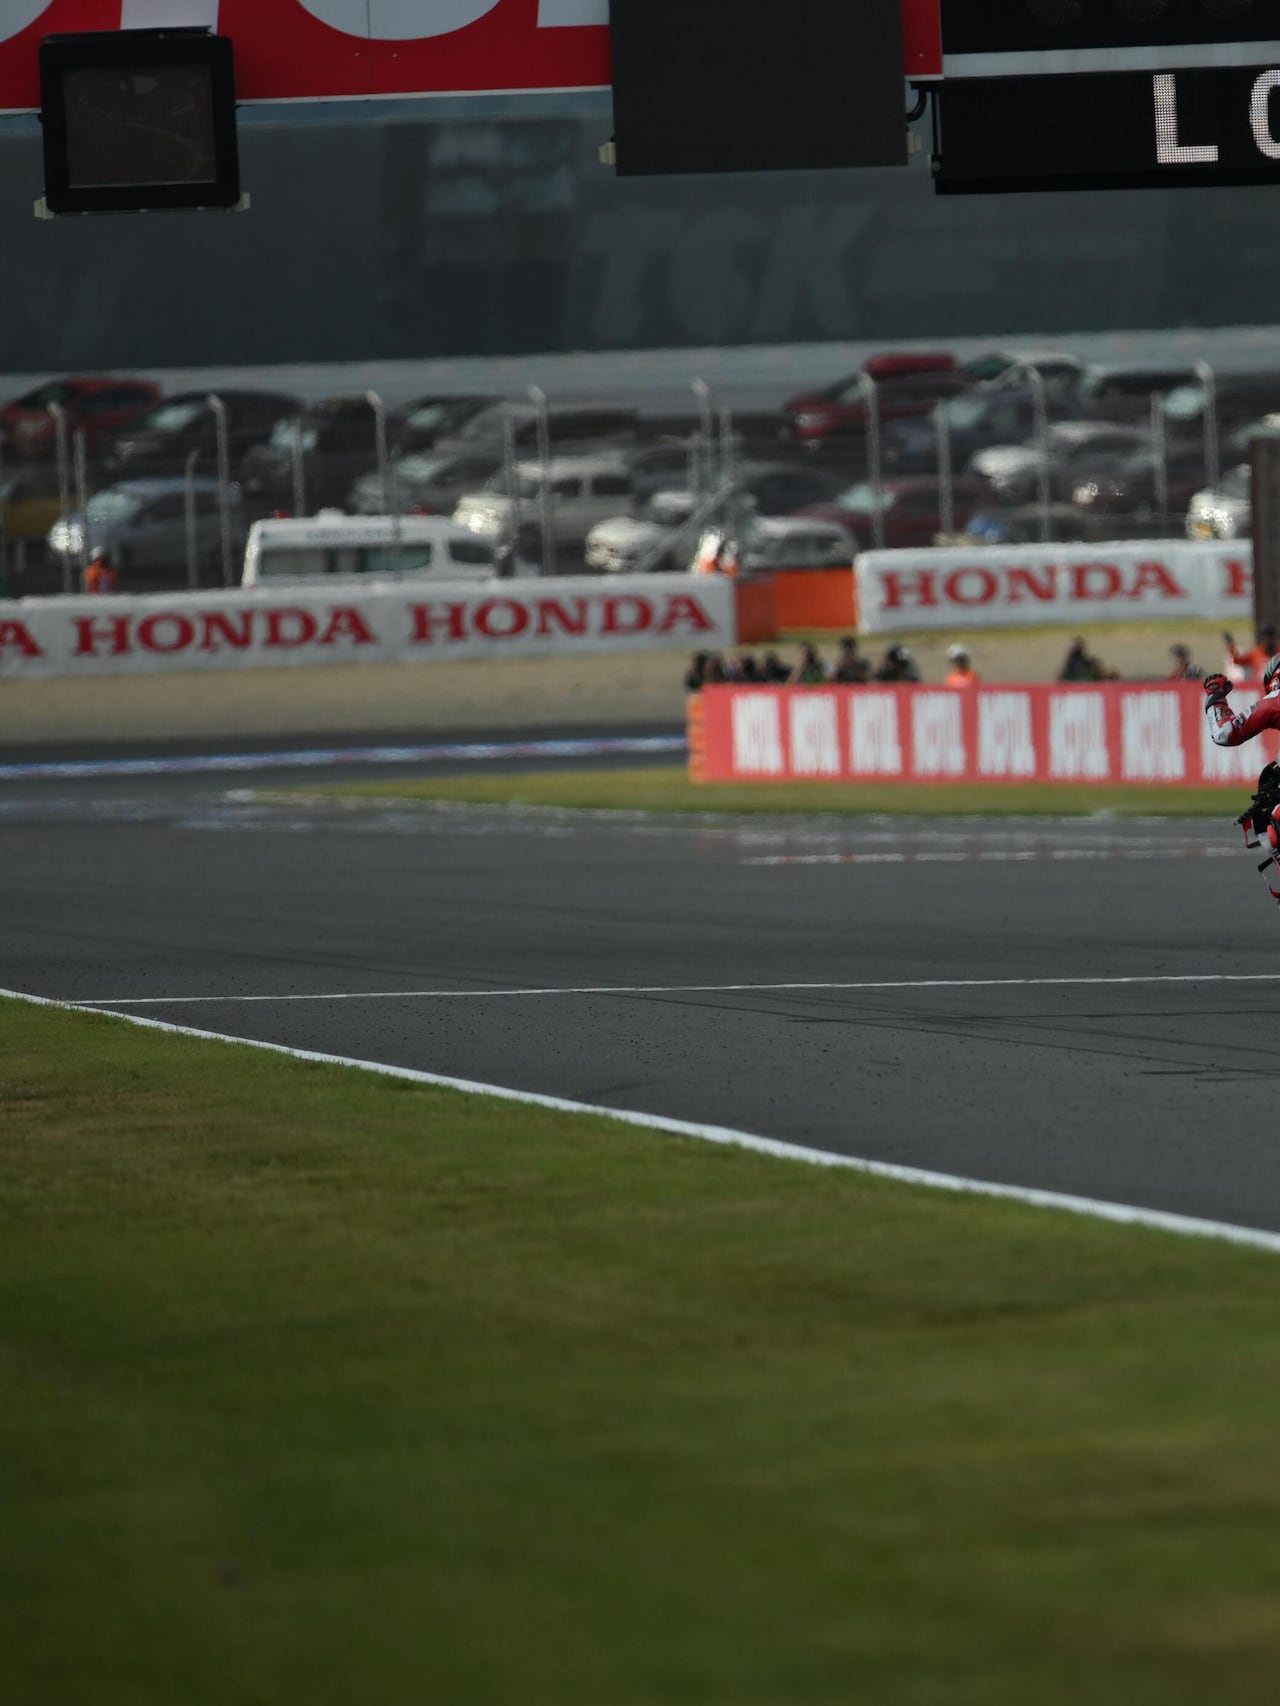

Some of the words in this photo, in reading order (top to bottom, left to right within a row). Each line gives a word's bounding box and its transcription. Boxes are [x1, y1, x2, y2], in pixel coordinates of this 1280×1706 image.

[1152, 74, 1219, 164] L
[878, 560, 1186, 611] HONDA
[72, 604, 378, 658] HONDA
[407, 592, 716, 647] HONDA
